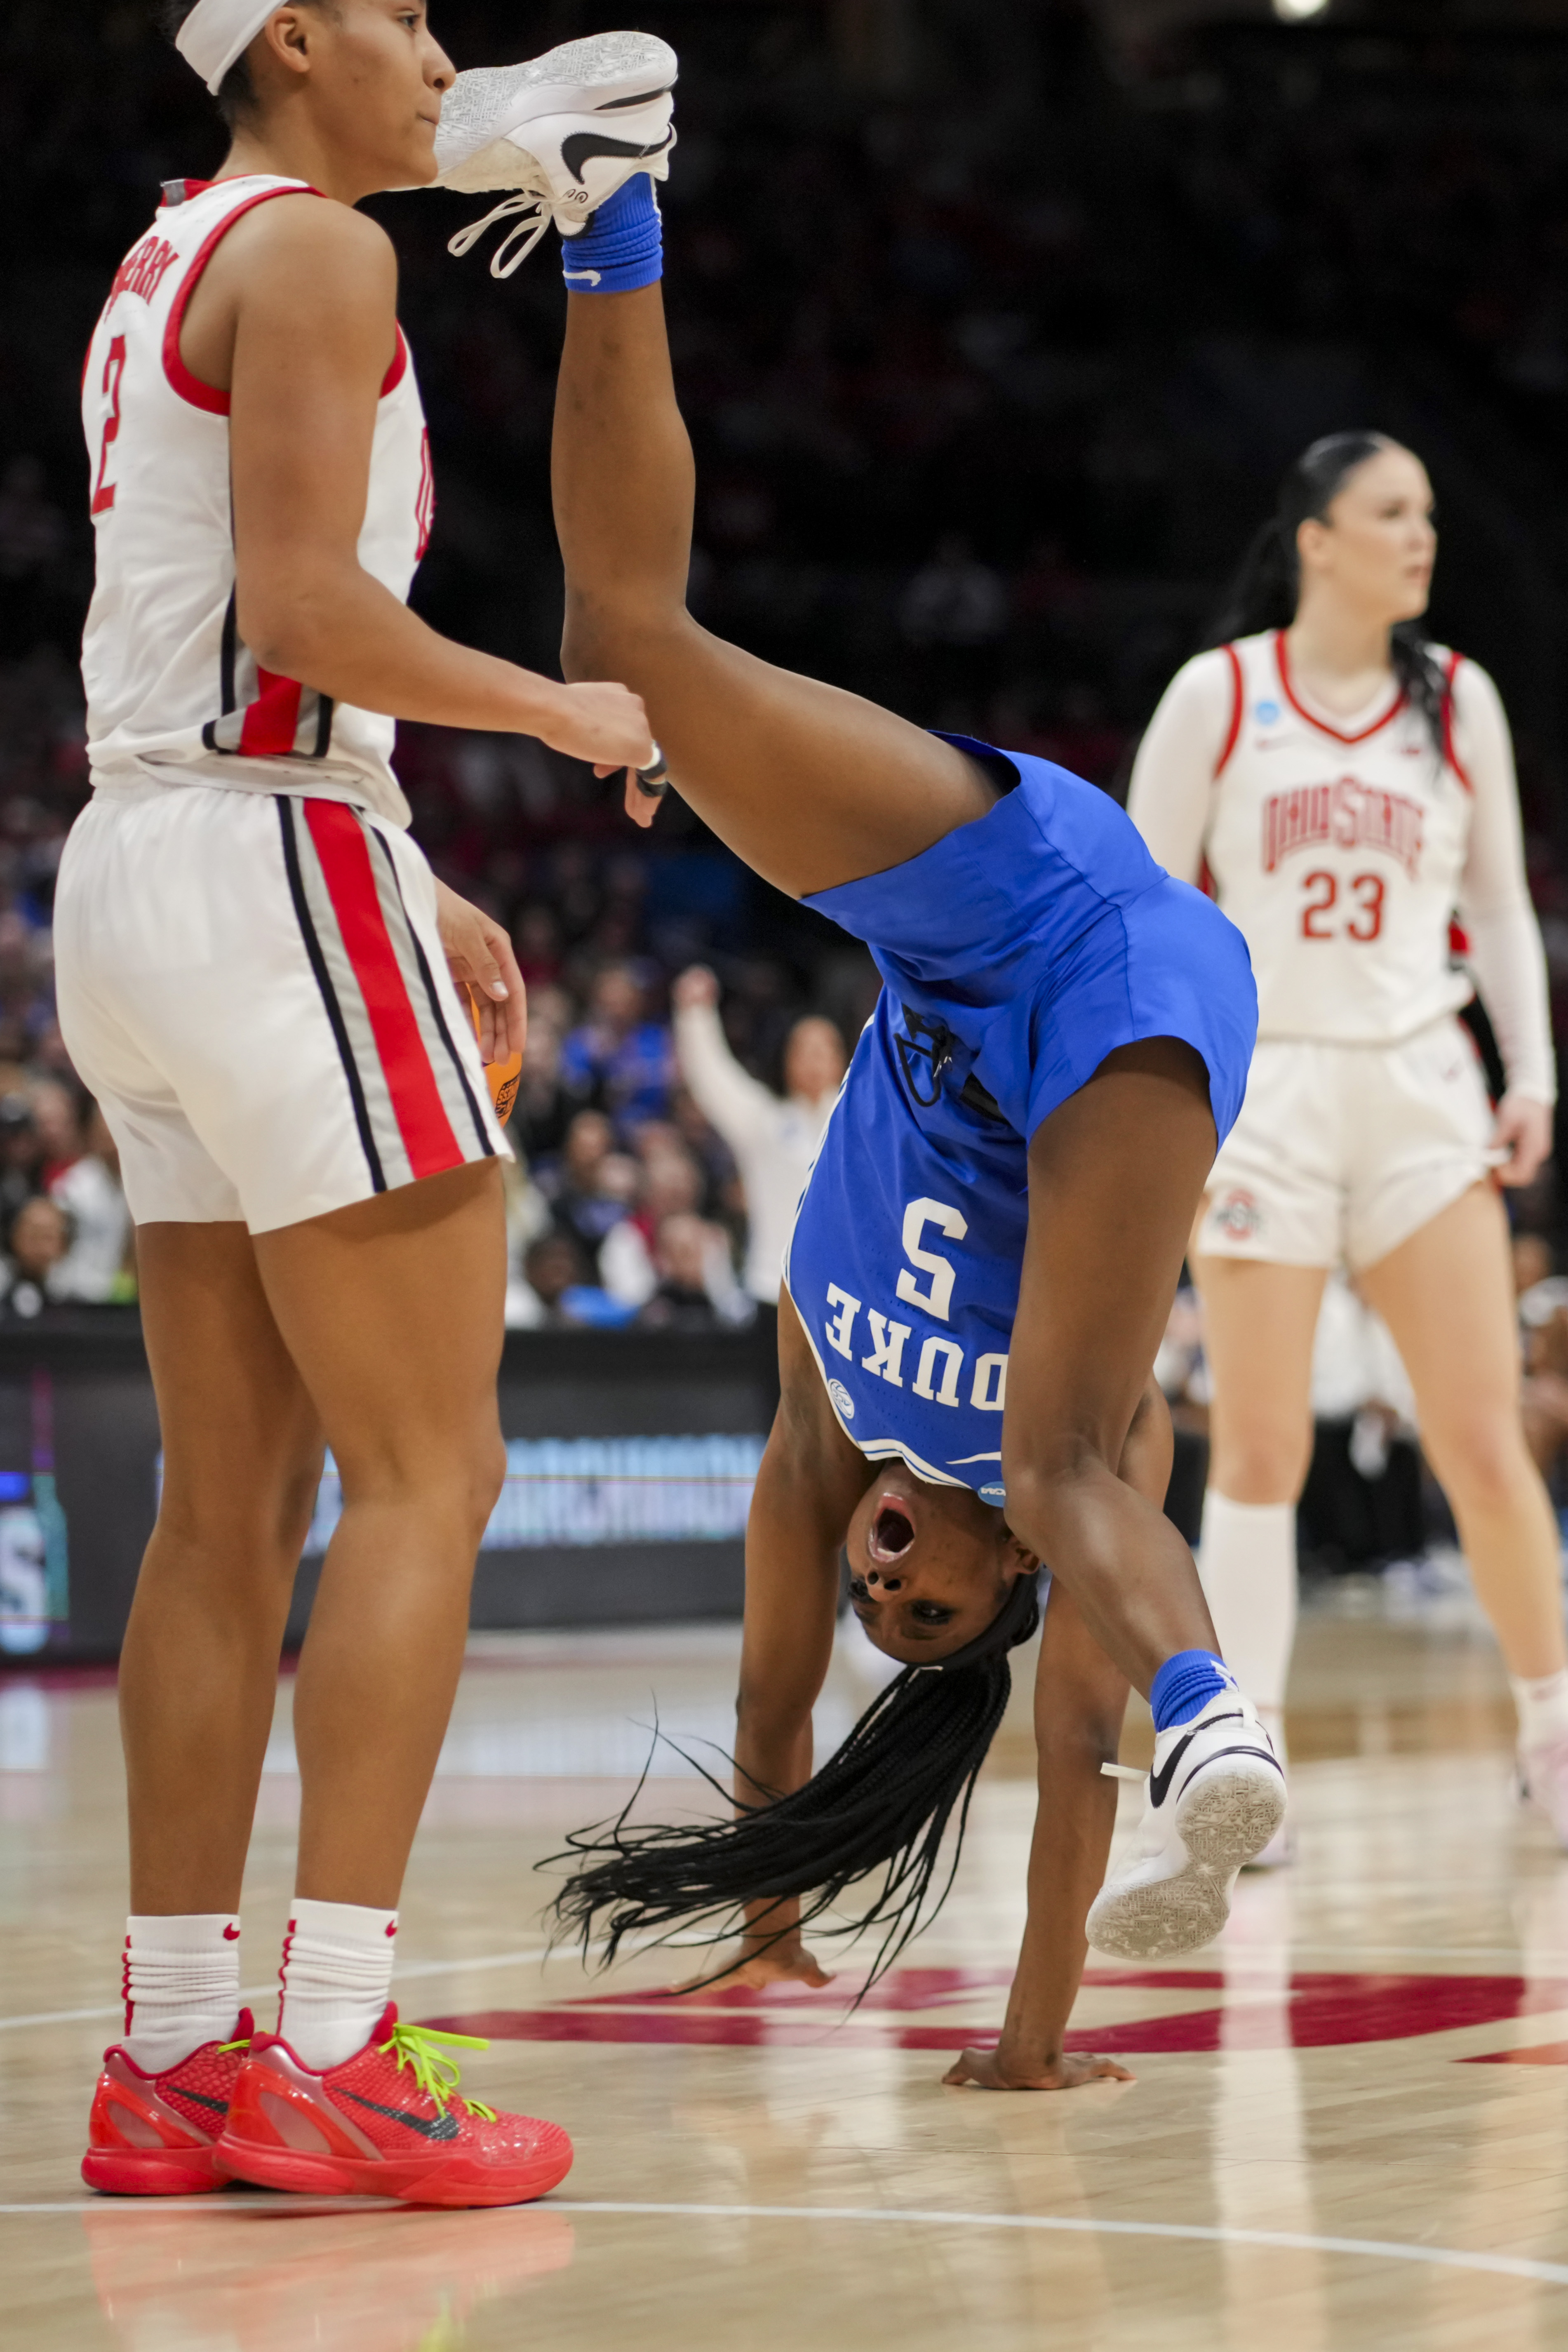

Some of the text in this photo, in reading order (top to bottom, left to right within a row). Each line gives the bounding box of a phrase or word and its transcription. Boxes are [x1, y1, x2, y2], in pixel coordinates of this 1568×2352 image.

[91, 334, 126, 515] 2
[1301, 871, 1386, 942] 23
[896, 1197, 968, 1322] 5
[825, 1282, 1009, 1411] DUKE
[980, 1487, 1006, 1496] CAA
